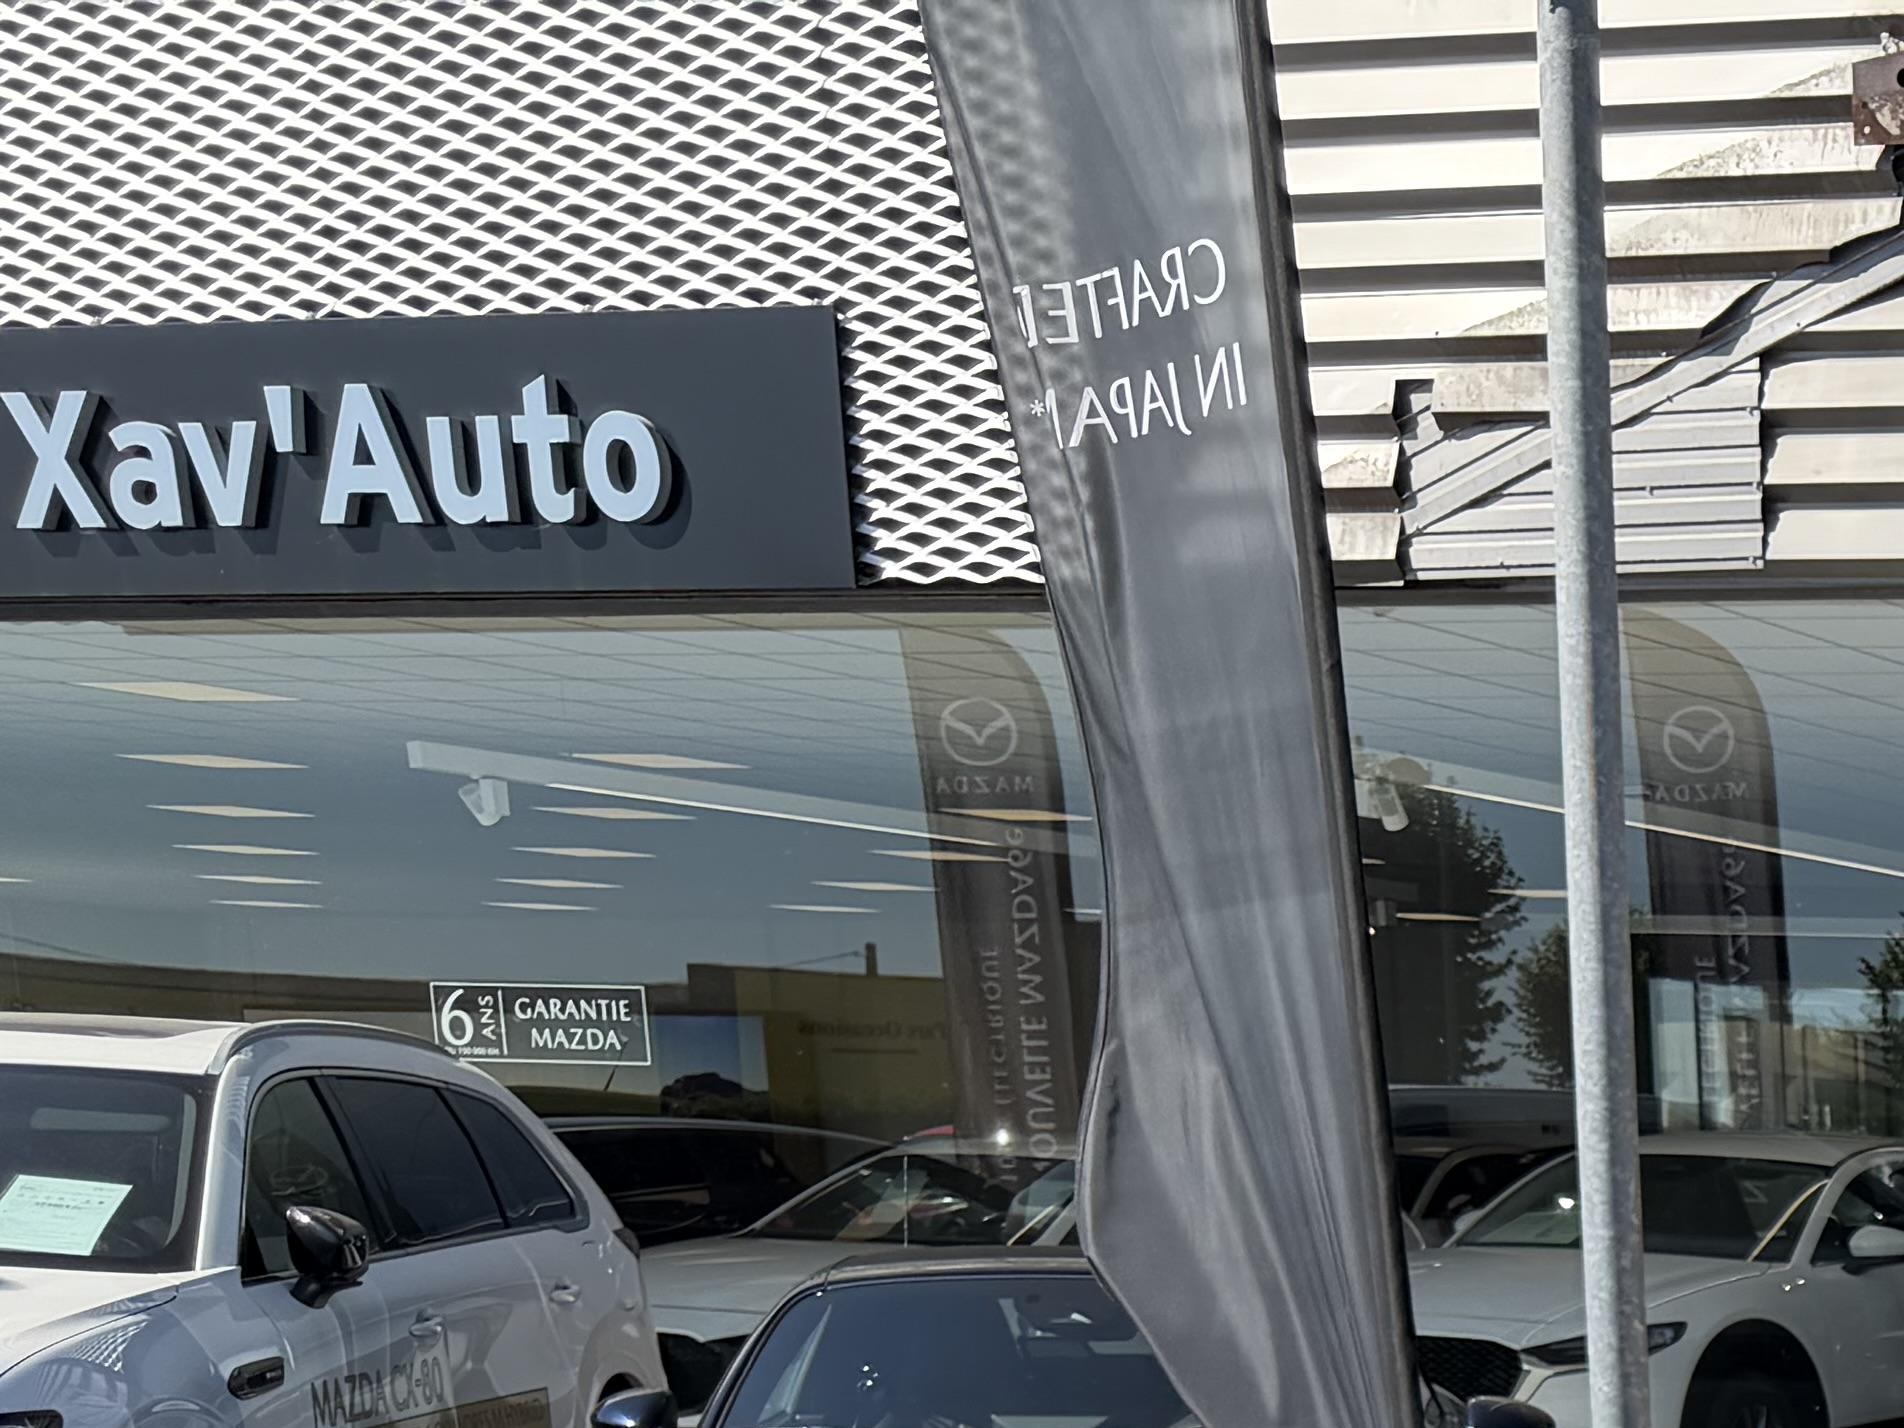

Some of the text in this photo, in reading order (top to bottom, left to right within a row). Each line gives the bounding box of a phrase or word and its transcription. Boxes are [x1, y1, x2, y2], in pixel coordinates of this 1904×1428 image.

[0, 373, 672, 531] Xav'Auto
[440, 988, 474, 1046] 6
[478, 994, 497, 1041] ANS
[514, 997, 632, 1022] GARANTIE
[531, 1027, 622, 1050] MAZDA
[390, 1356, 444, 1412] CX-80
